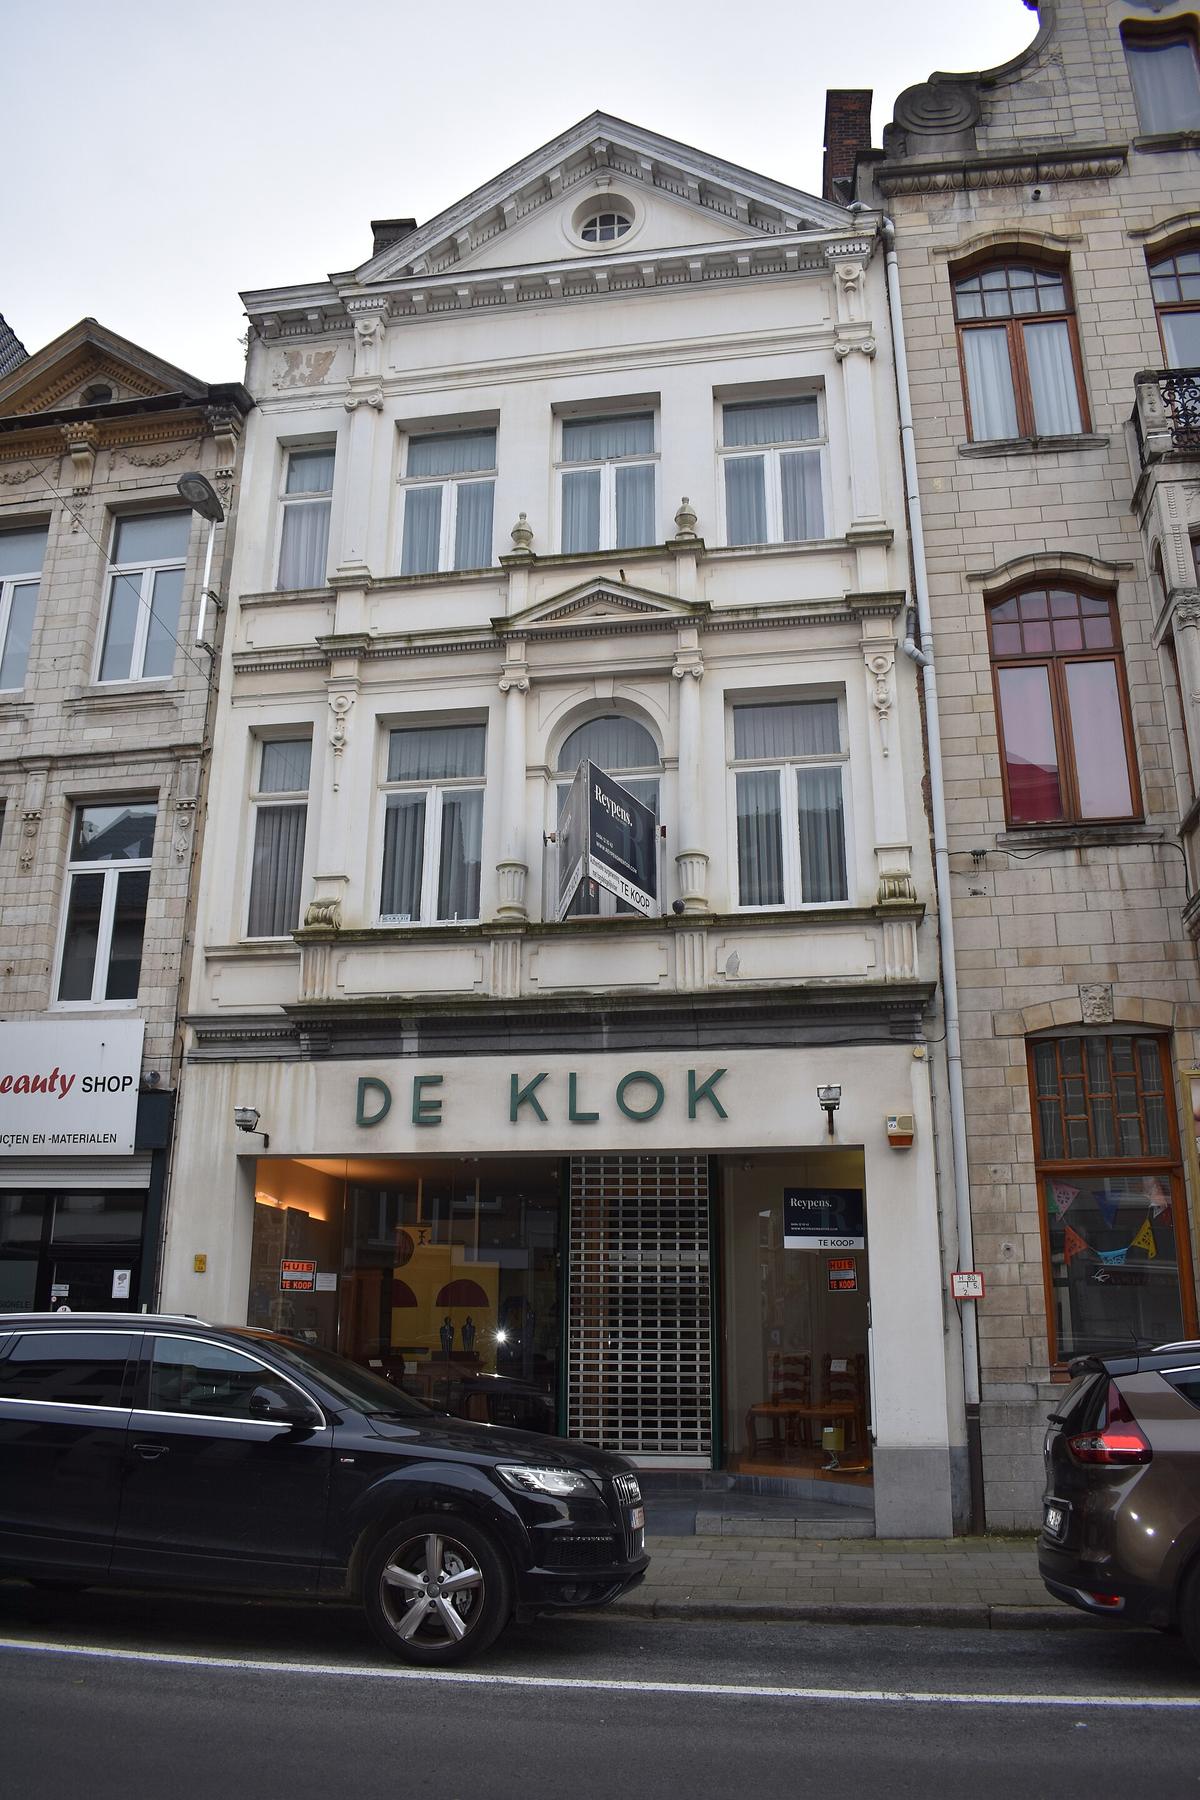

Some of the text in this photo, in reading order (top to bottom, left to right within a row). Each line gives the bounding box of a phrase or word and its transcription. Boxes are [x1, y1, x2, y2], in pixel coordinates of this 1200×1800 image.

[594, 784, 633, 827] Reypens.
[620, 881, 650, 910] TE KOOP
[81, 1075, 133, 1093] SHOP
[356, 1068, 730, 1127] DE KLOK
[32, 1134, 46, 1144] EN
[48, 1133, 117, 1144] -MATERIALEN
[790, 1197, 832, 1210] Reypens.
[818, 1239, 855, 1247] TE KOOP
[283, 1262, 313, 1271] HUIS
[281, 1280, 291, 1289] TE
[293, 1281, 313, 1290] KOOP
[830, 1280, 855, 1289] TE KOOP
